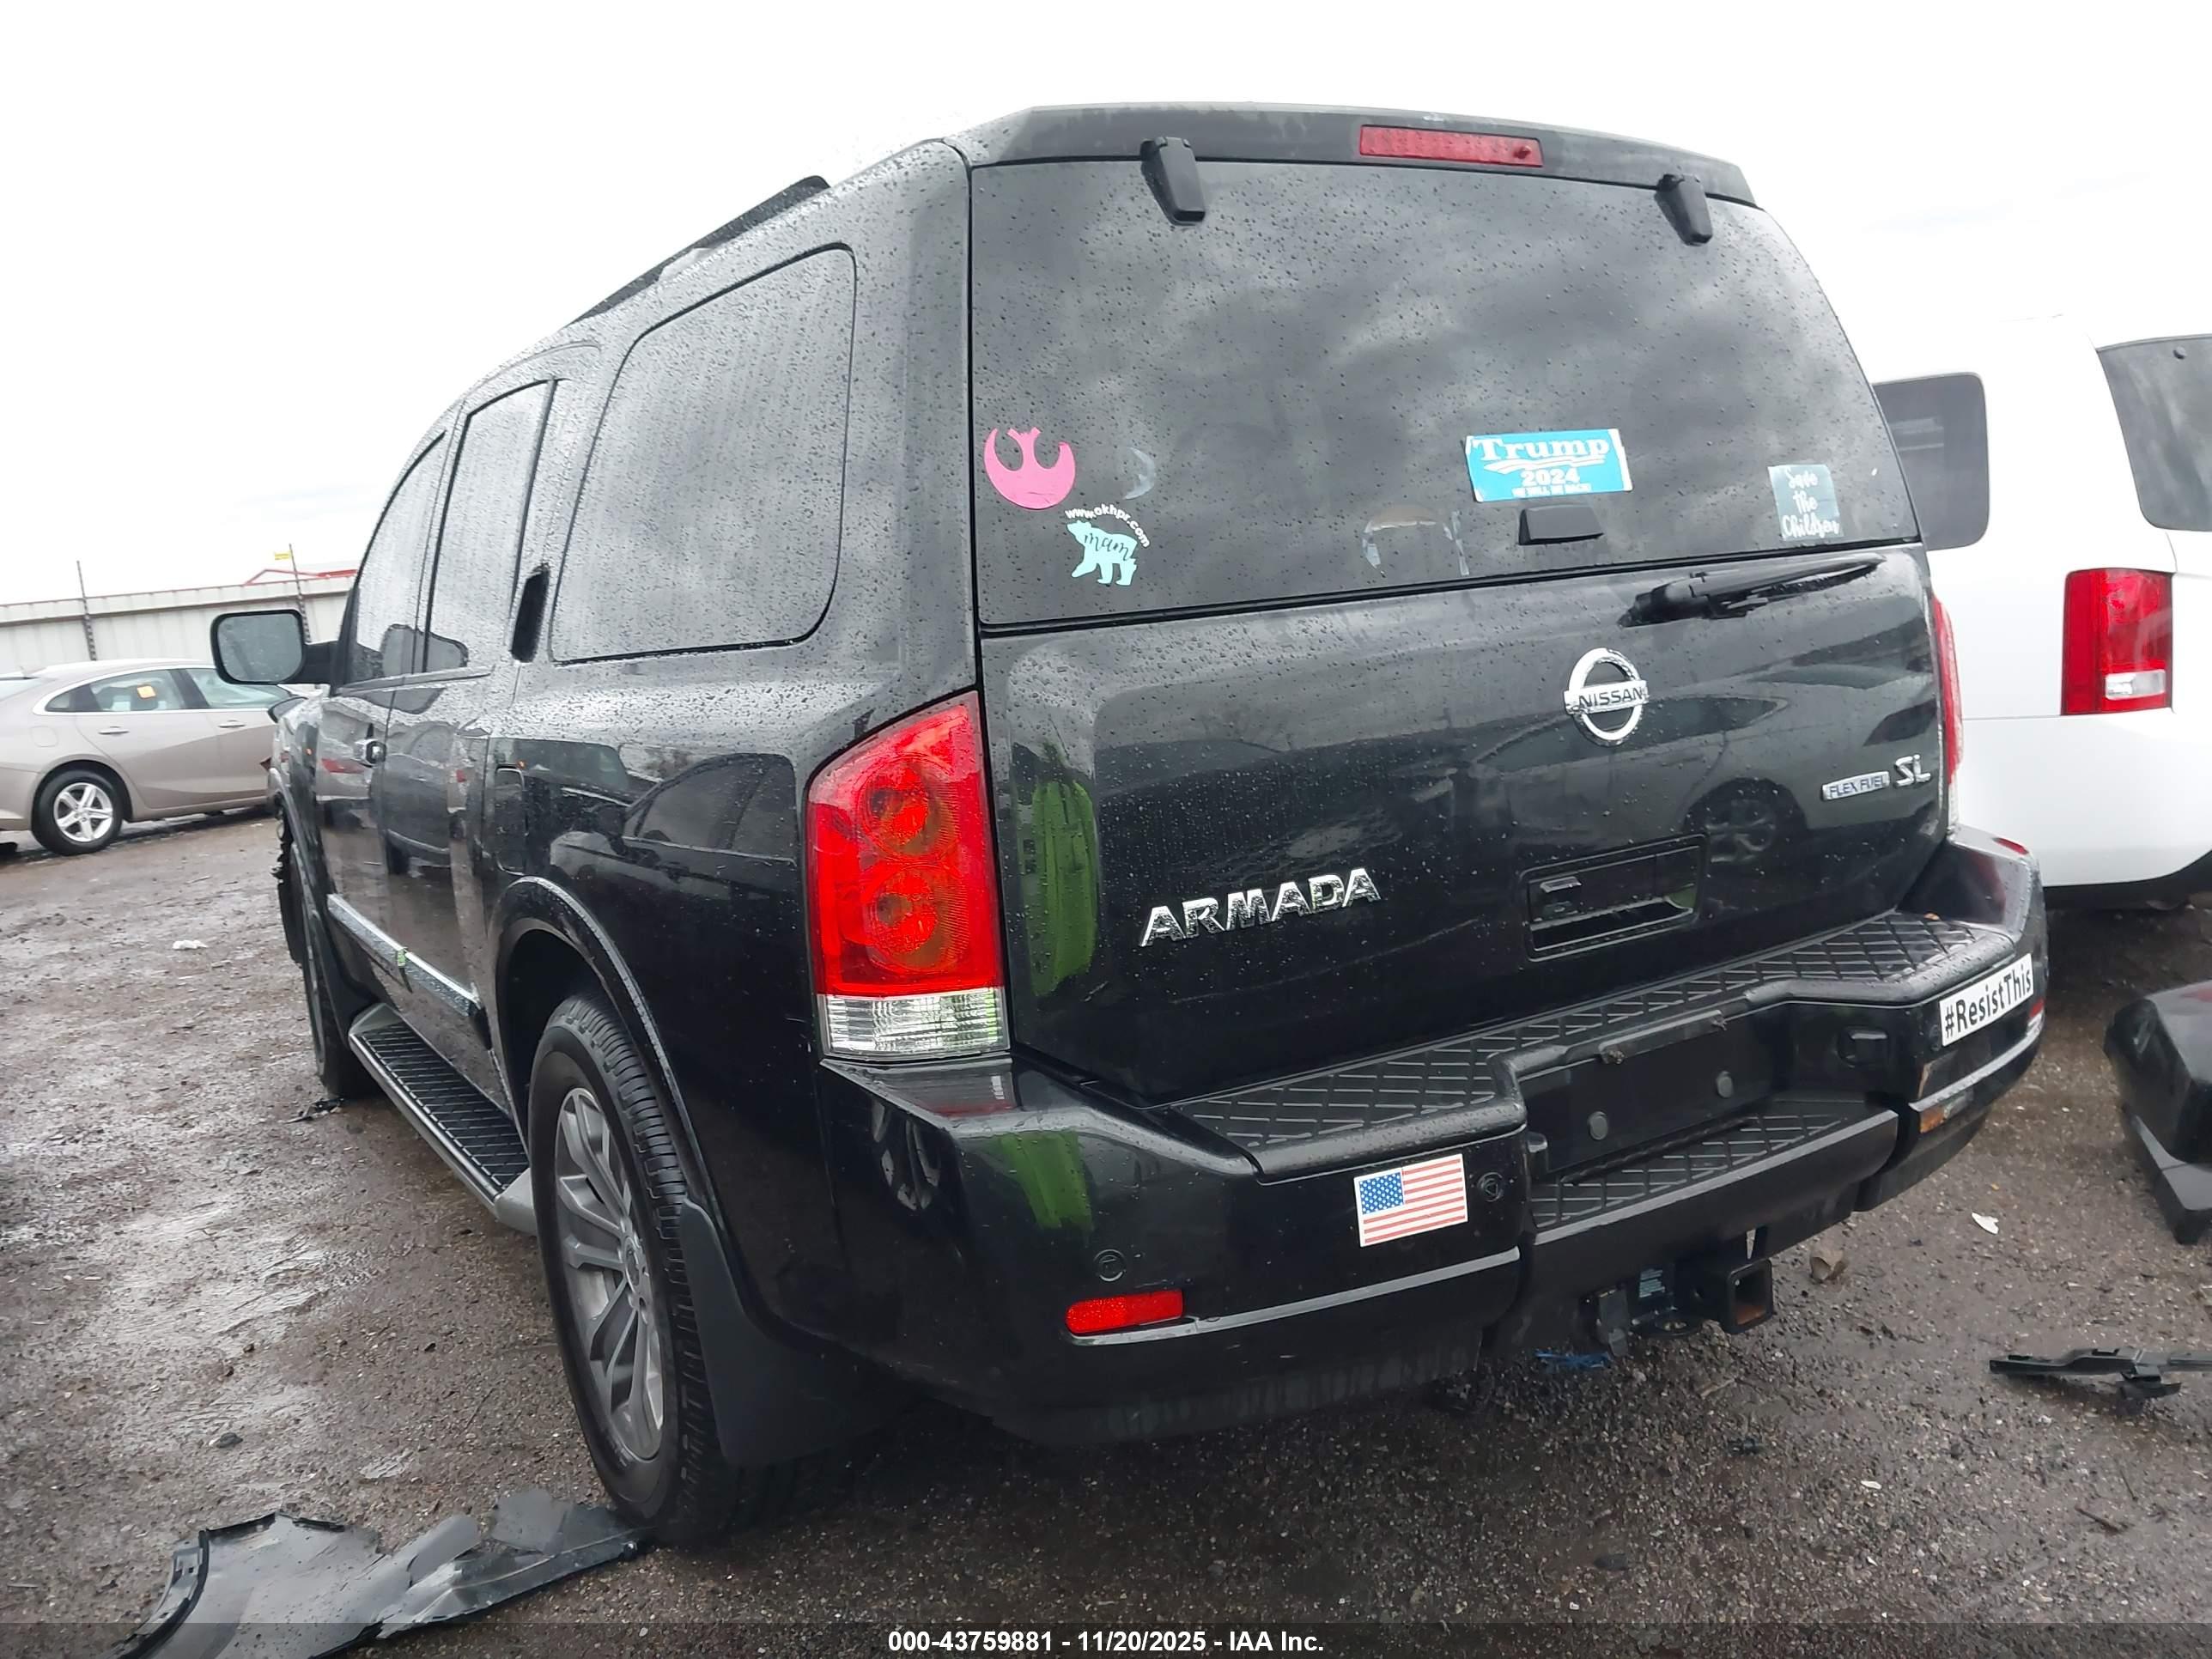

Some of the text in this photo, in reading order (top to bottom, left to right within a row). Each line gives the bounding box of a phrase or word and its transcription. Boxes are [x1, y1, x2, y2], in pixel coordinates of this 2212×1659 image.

[1472, 437, 1610, 462] Trump
[1521, 467, 1580, 487] 2024
[1792, 489, 1819, 514] the
[1577, 685, 1644, 709] NISSAN
[1894, 754, 1932, 787] SL
[1828, 775, 1887, 798] FLEX FUEL
[1139, 867, 1382, 947] ARMADA
[1945, 963, 2032, 1039] #ResistThis
